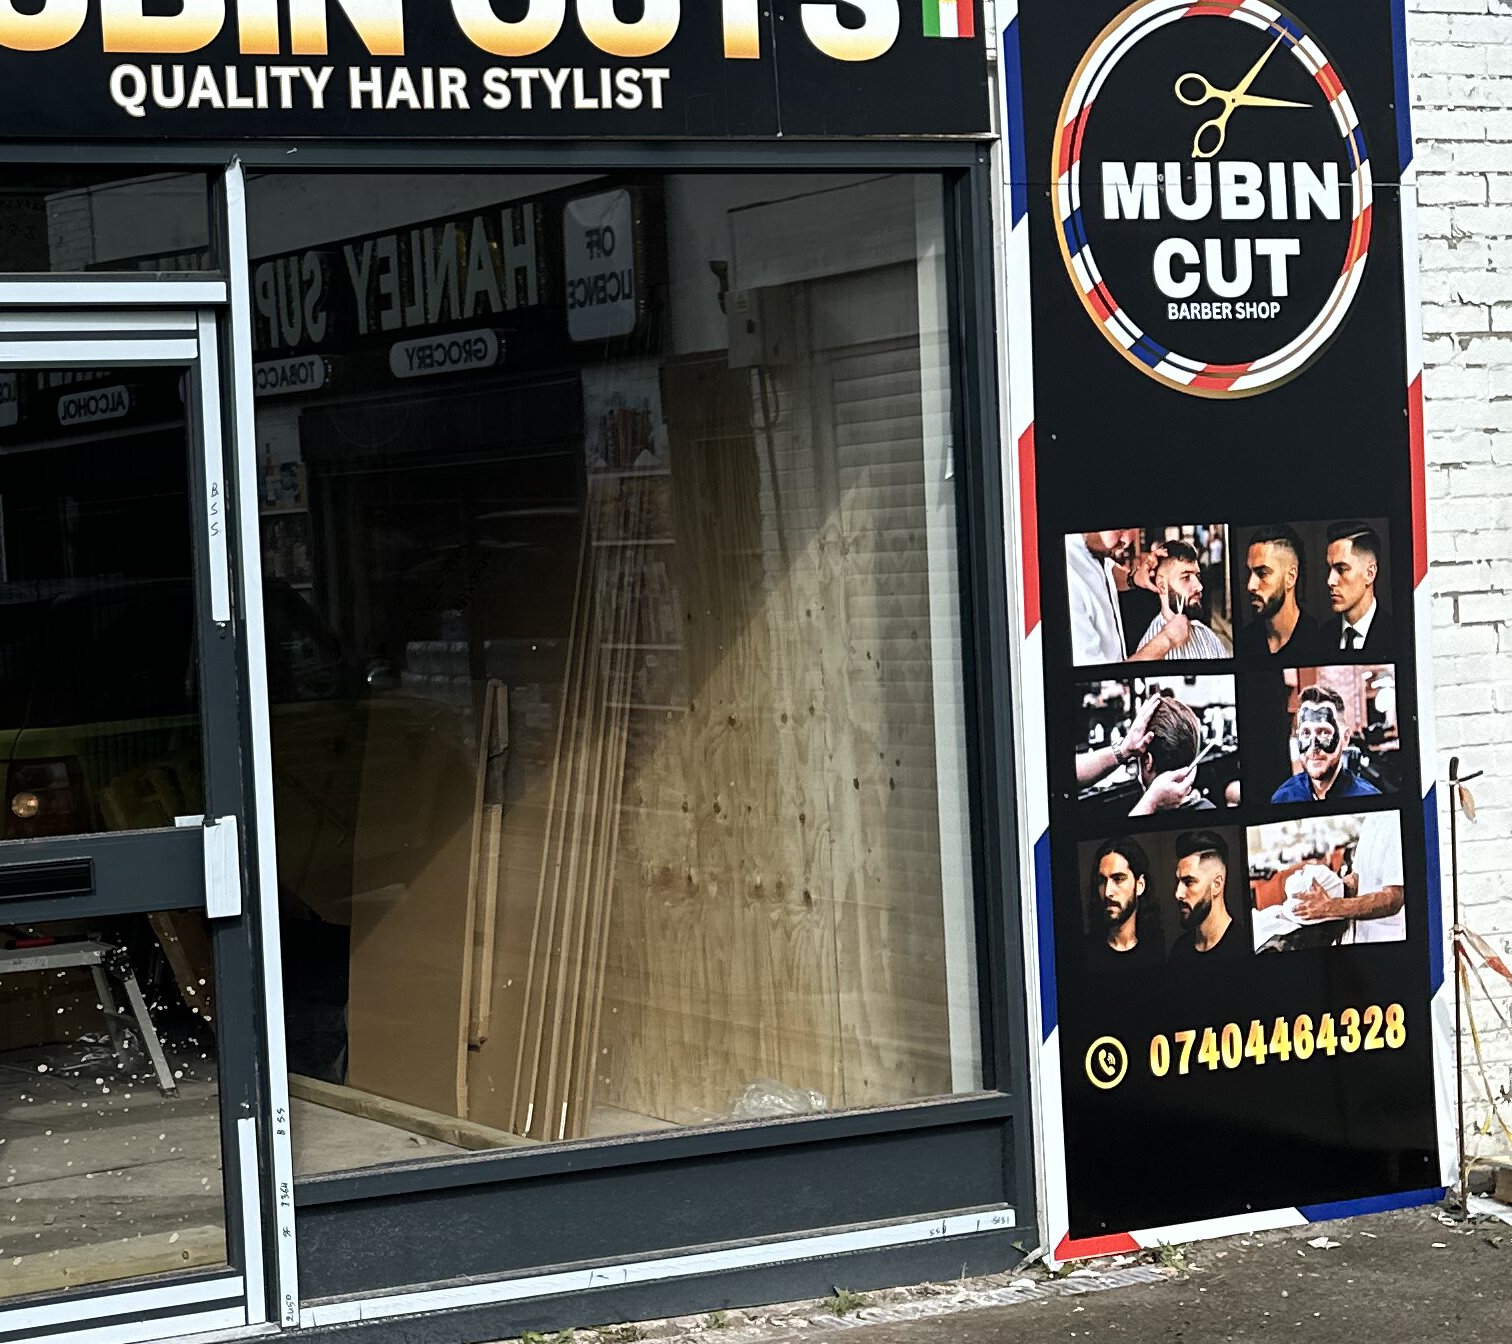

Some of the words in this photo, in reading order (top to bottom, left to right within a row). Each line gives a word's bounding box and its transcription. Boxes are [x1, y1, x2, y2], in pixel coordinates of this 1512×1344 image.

[109, 63, 335, 117] QUALITY
[348, 65, 470, 110] HAIR
[482, 66, 671, 111] STYLIST
[1101, 160, 1341, 221] MUBIN
[1153, 237, 1301, 299] CUT
[1167, 302, 1233, 320] BARBER
[1235, 301, 1281, 319] SHOP
[1149, 1003, 1407, 1077] 07404464328
